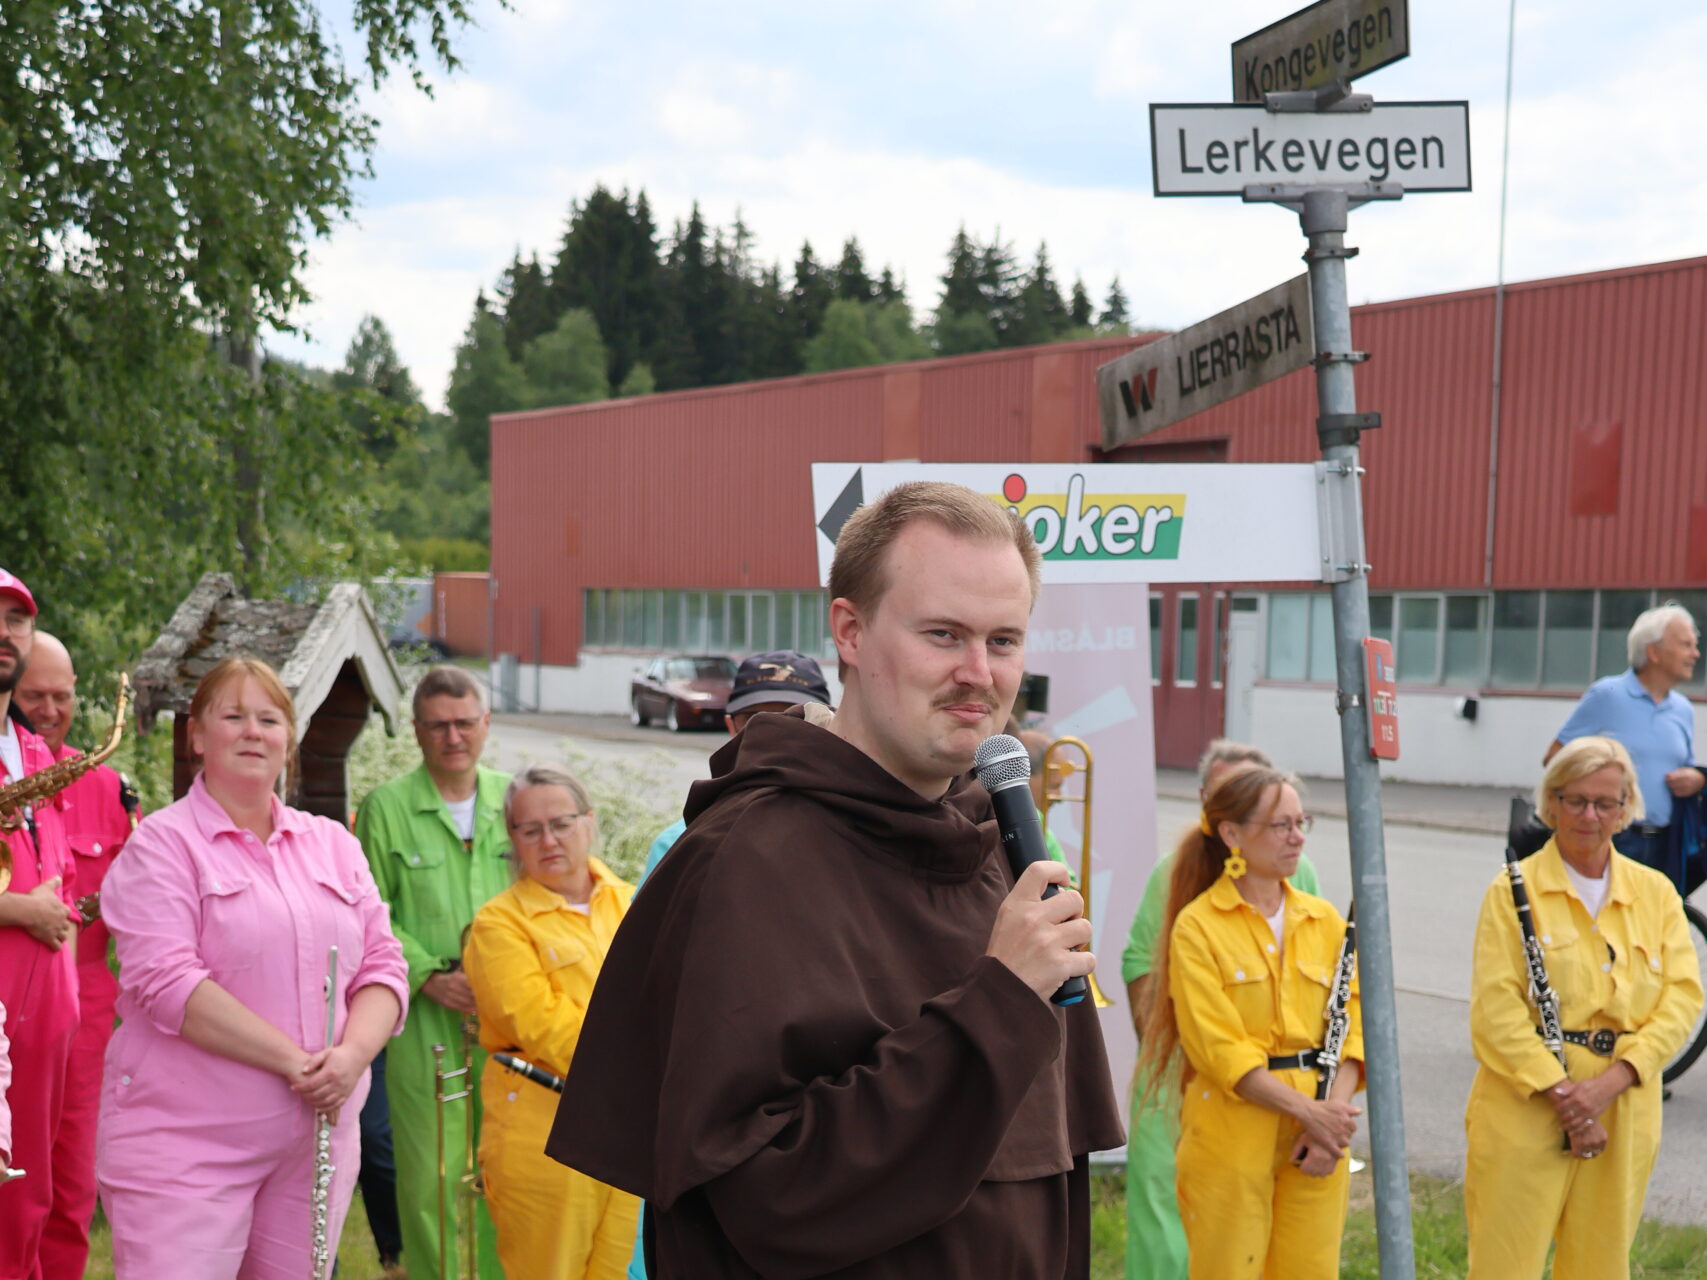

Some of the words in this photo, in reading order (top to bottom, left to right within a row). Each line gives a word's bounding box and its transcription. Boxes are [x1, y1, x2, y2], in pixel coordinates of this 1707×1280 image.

[1244, 6, 1393, 101] Kongevegen
[1178, 127, 1445, 182] Lerkevegen
[1176, 303, 1302, 397] LIERRASTA
